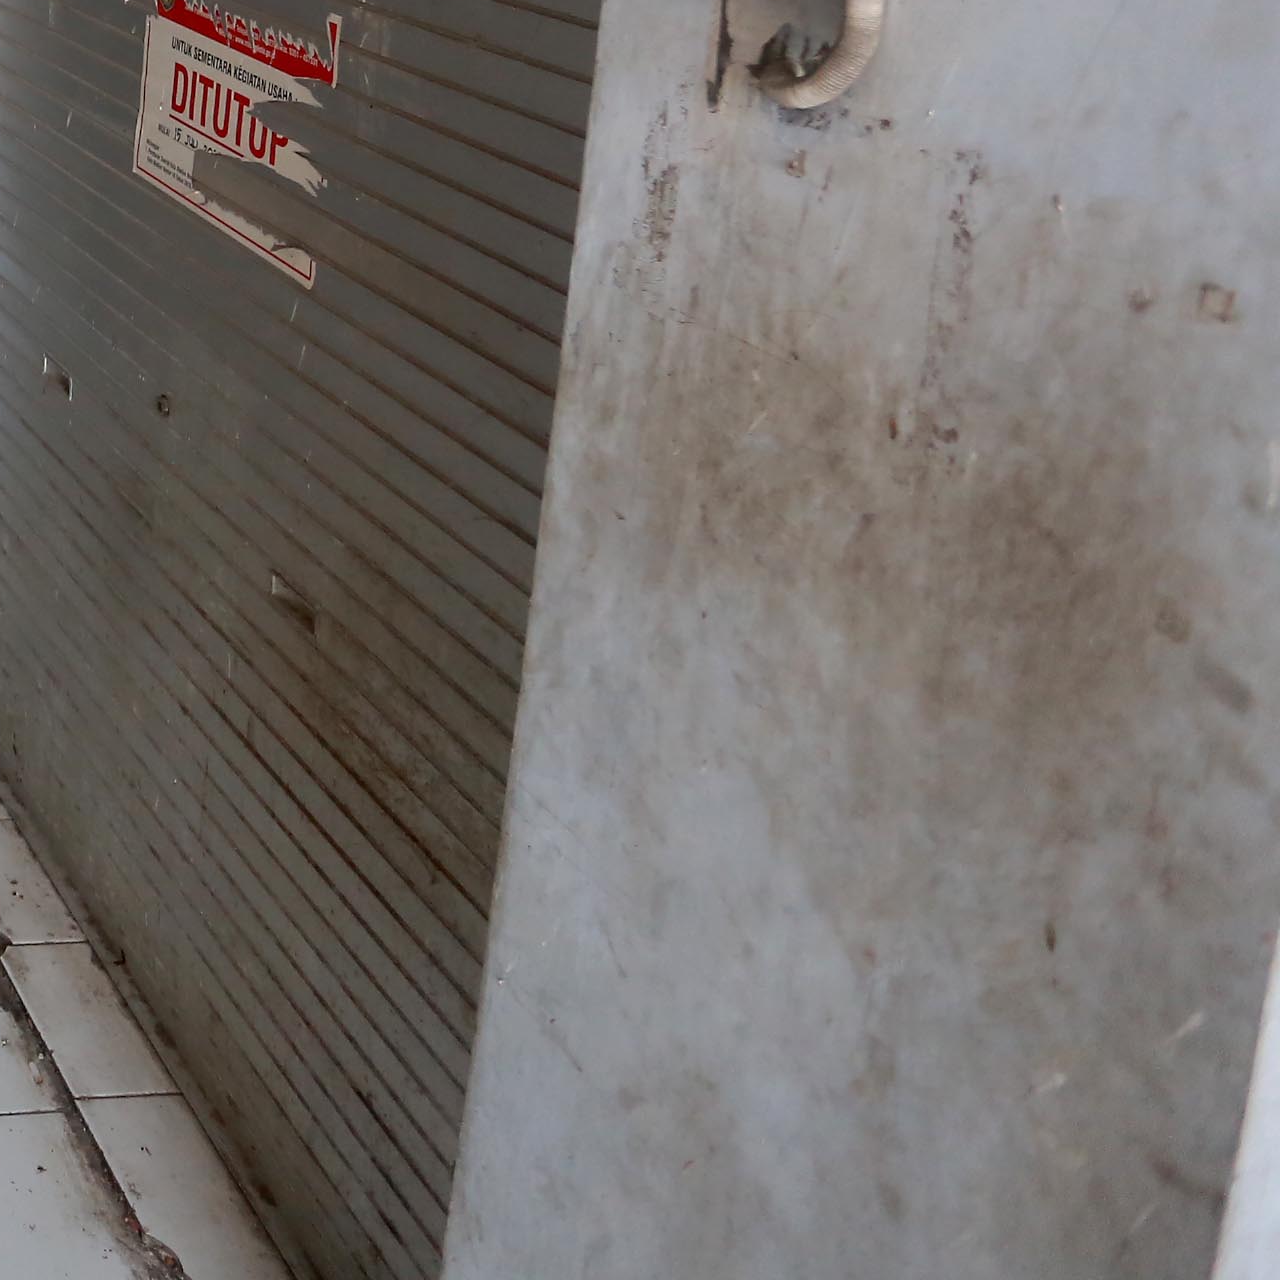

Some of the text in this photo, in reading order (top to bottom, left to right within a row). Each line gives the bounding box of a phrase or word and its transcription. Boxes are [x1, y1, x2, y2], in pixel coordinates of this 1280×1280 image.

[171, 36, 192, 57] UNTUK
[193, 46, 232, 77] SEMENTARA
[171, 61, 289, 167] DITUTUP
